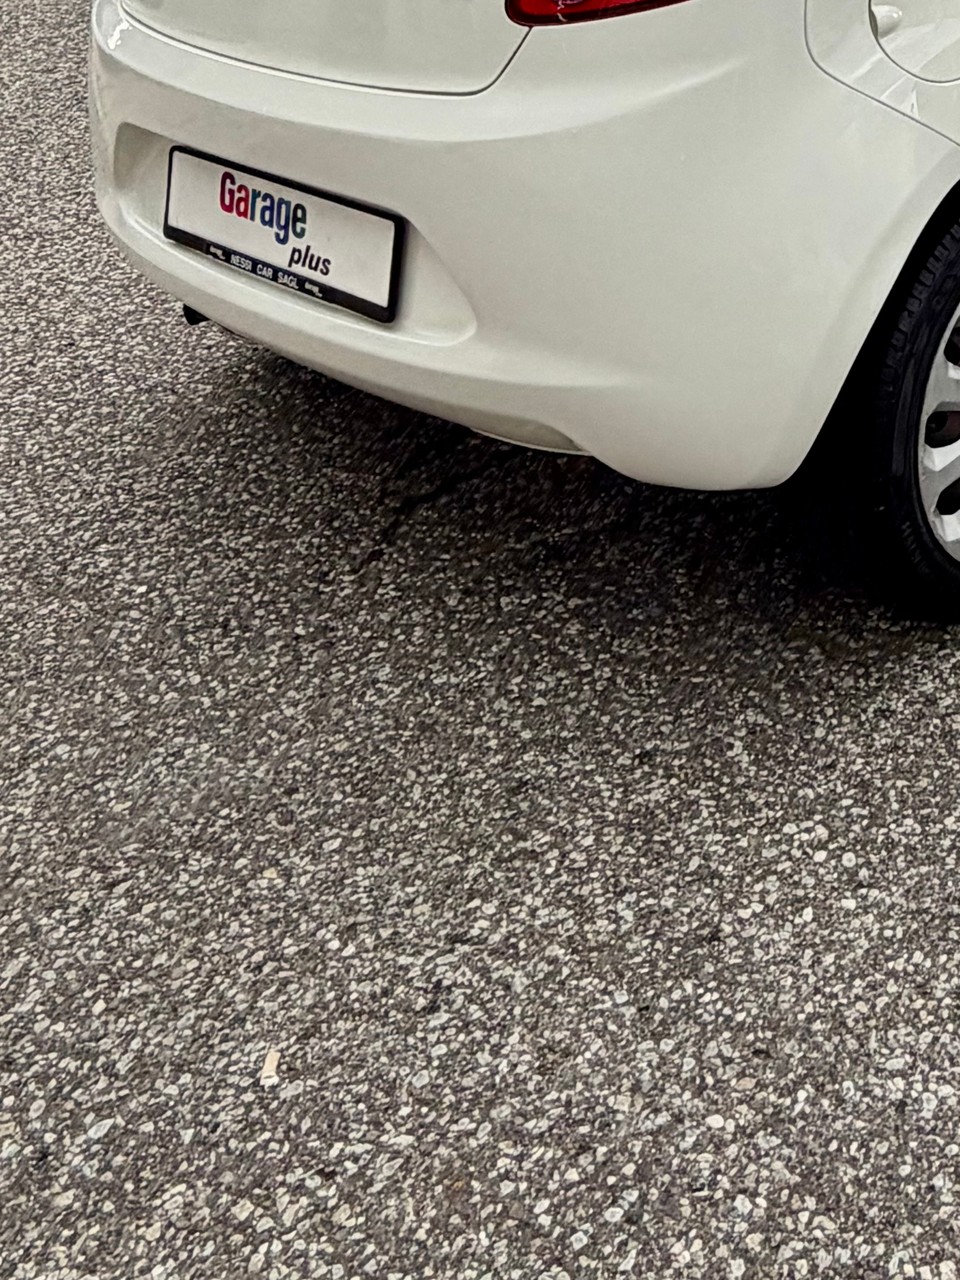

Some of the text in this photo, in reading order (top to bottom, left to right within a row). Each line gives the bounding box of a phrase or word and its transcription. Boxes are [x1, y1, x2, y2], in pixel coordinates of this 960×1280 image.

[220, 171, 307, 245] Garage
[256, 264, 273, 279] CAR
[288, 245, 331, 276] plus
